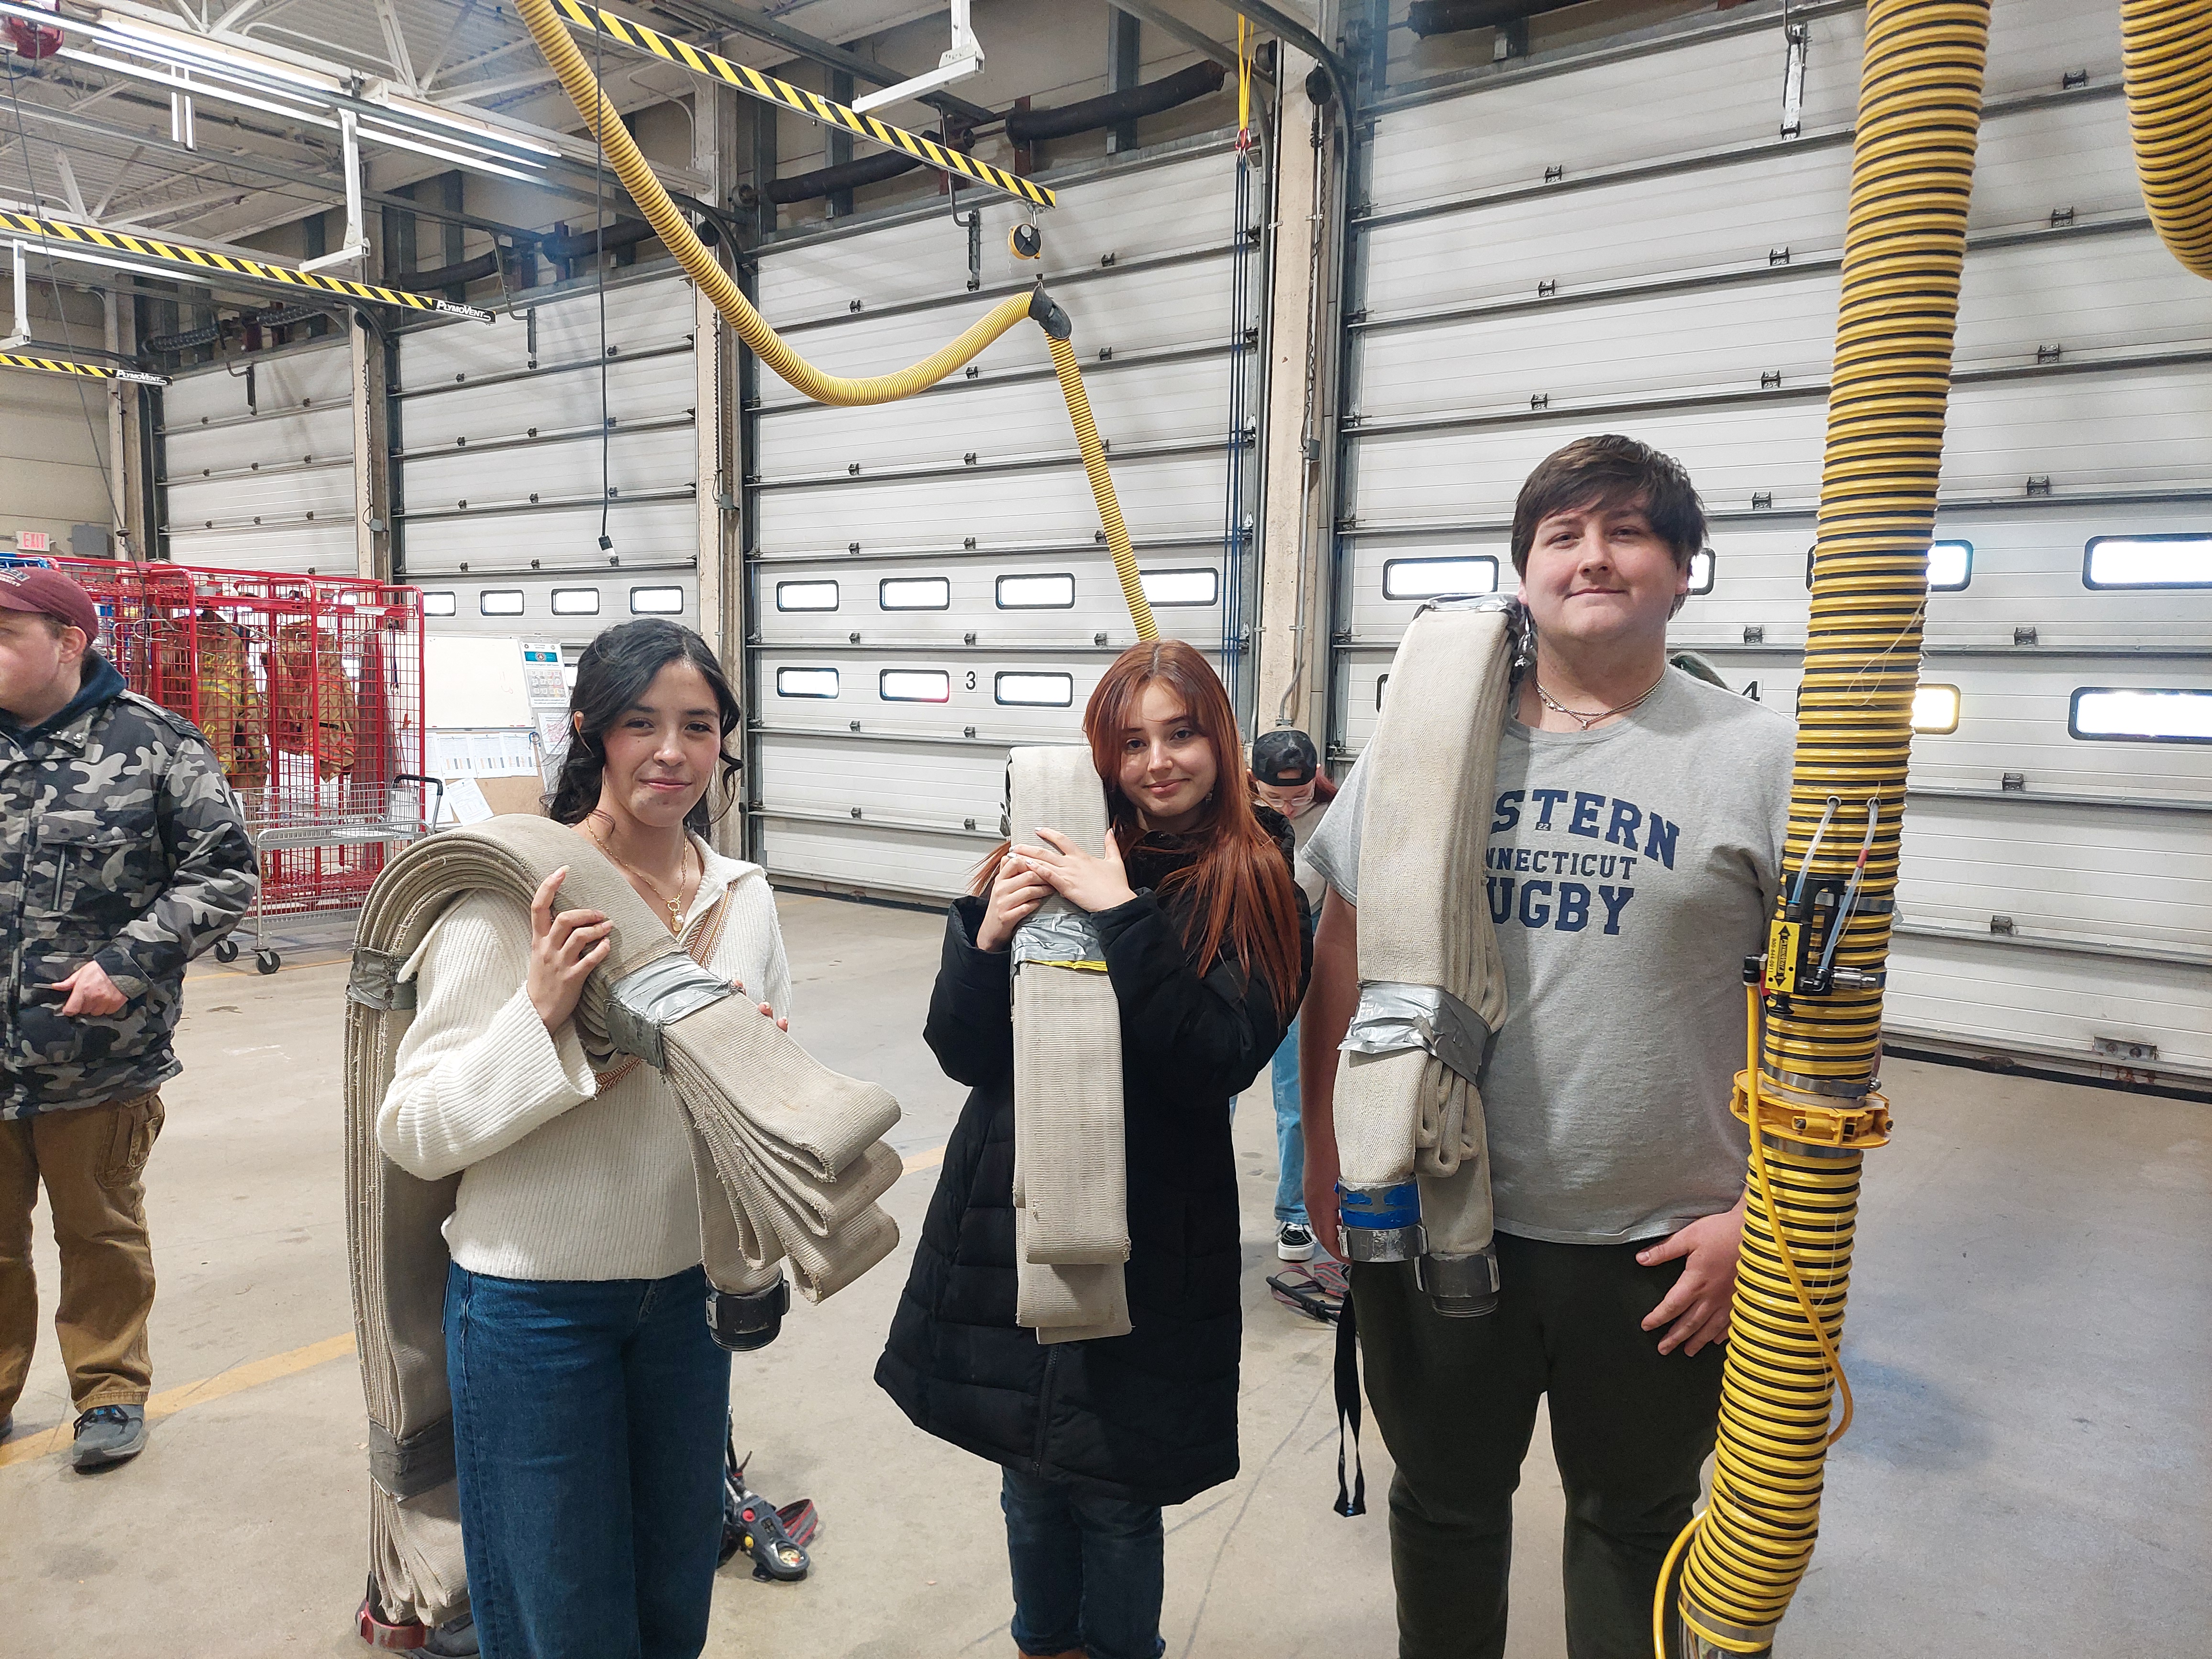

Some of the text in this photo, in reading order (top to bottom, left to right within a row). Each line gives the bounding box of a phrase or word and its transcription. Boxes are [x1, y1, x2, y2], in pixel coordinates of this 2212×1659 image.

[23, 532, 45, 549] EXIT
[965, 671, 976, 690] 3
[1741, 681, 1760, 702] 4
[1490, 789, 1681, 871] STERN
[1486, 876, 1635, 935] UGBY
